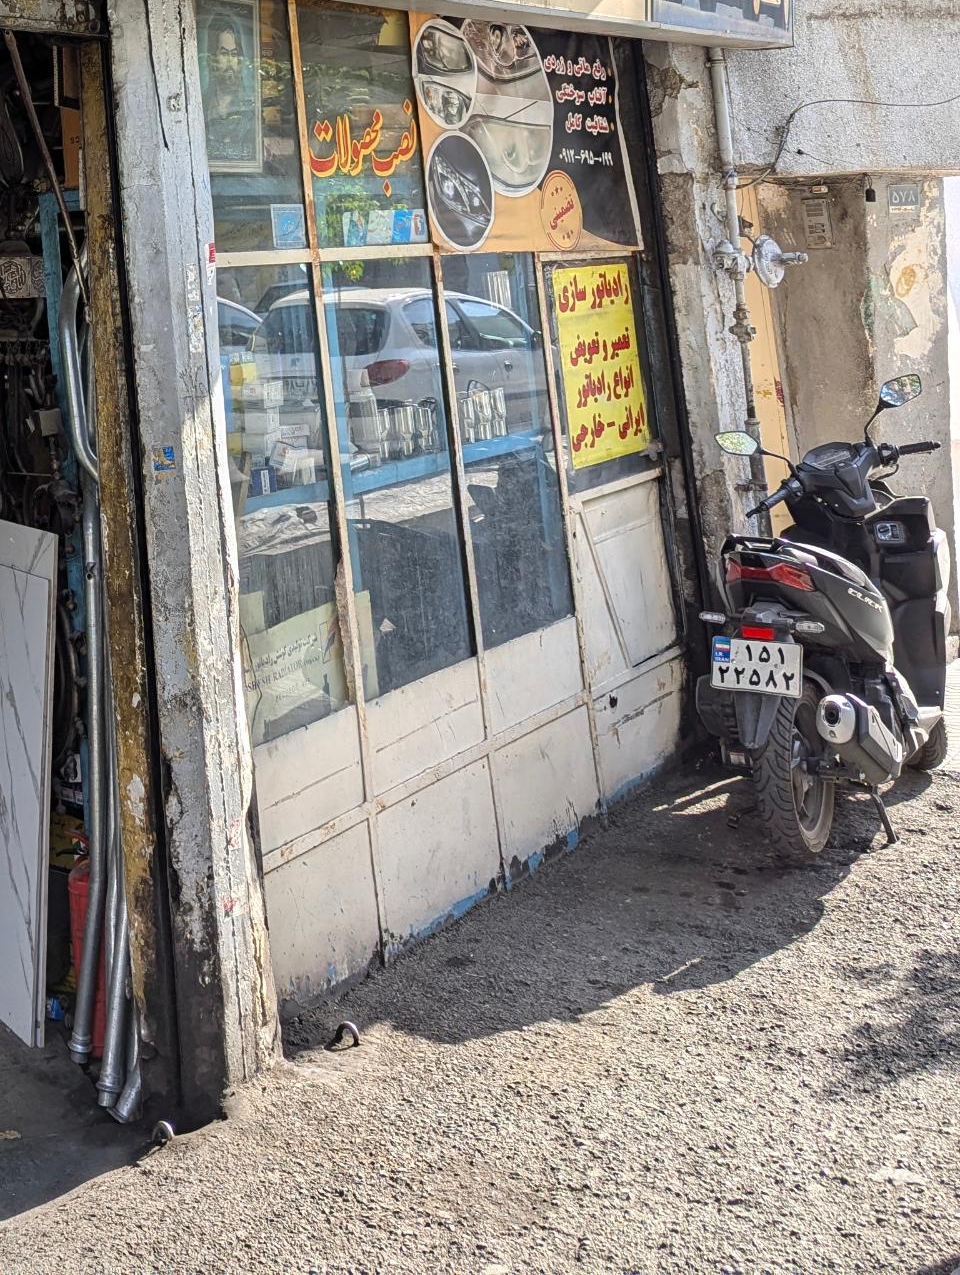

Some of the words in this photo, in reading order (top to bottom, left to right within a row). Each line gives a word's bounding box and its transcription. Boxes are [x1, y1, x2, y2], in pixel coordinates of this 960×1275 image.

[309, 108, 383, 178] محصولات
[371, 99, 417, 197] نصب
[550, 193, 574, 230] تضمینی
[892, 190, 916, 204] ۵۷۸
[558, 274, 586, 313] سازی
[591, 270, 629, 309] رادیاتور
[570, 331, 599, 366] تعویض
[602, 339, 608, 361] و
[610, 327, 631, 360] تعمیر
[577, 370, 611, 408] رادیاتور
[613, 365, 634, 399] انواع
[572, 413, 605, 452] خارجی
[618, 402, 645, 440] ایرانی
[745, 644, 785, 665] ۱۵۱
[718, 666, 795, 691] ۲۲۵۸۲
